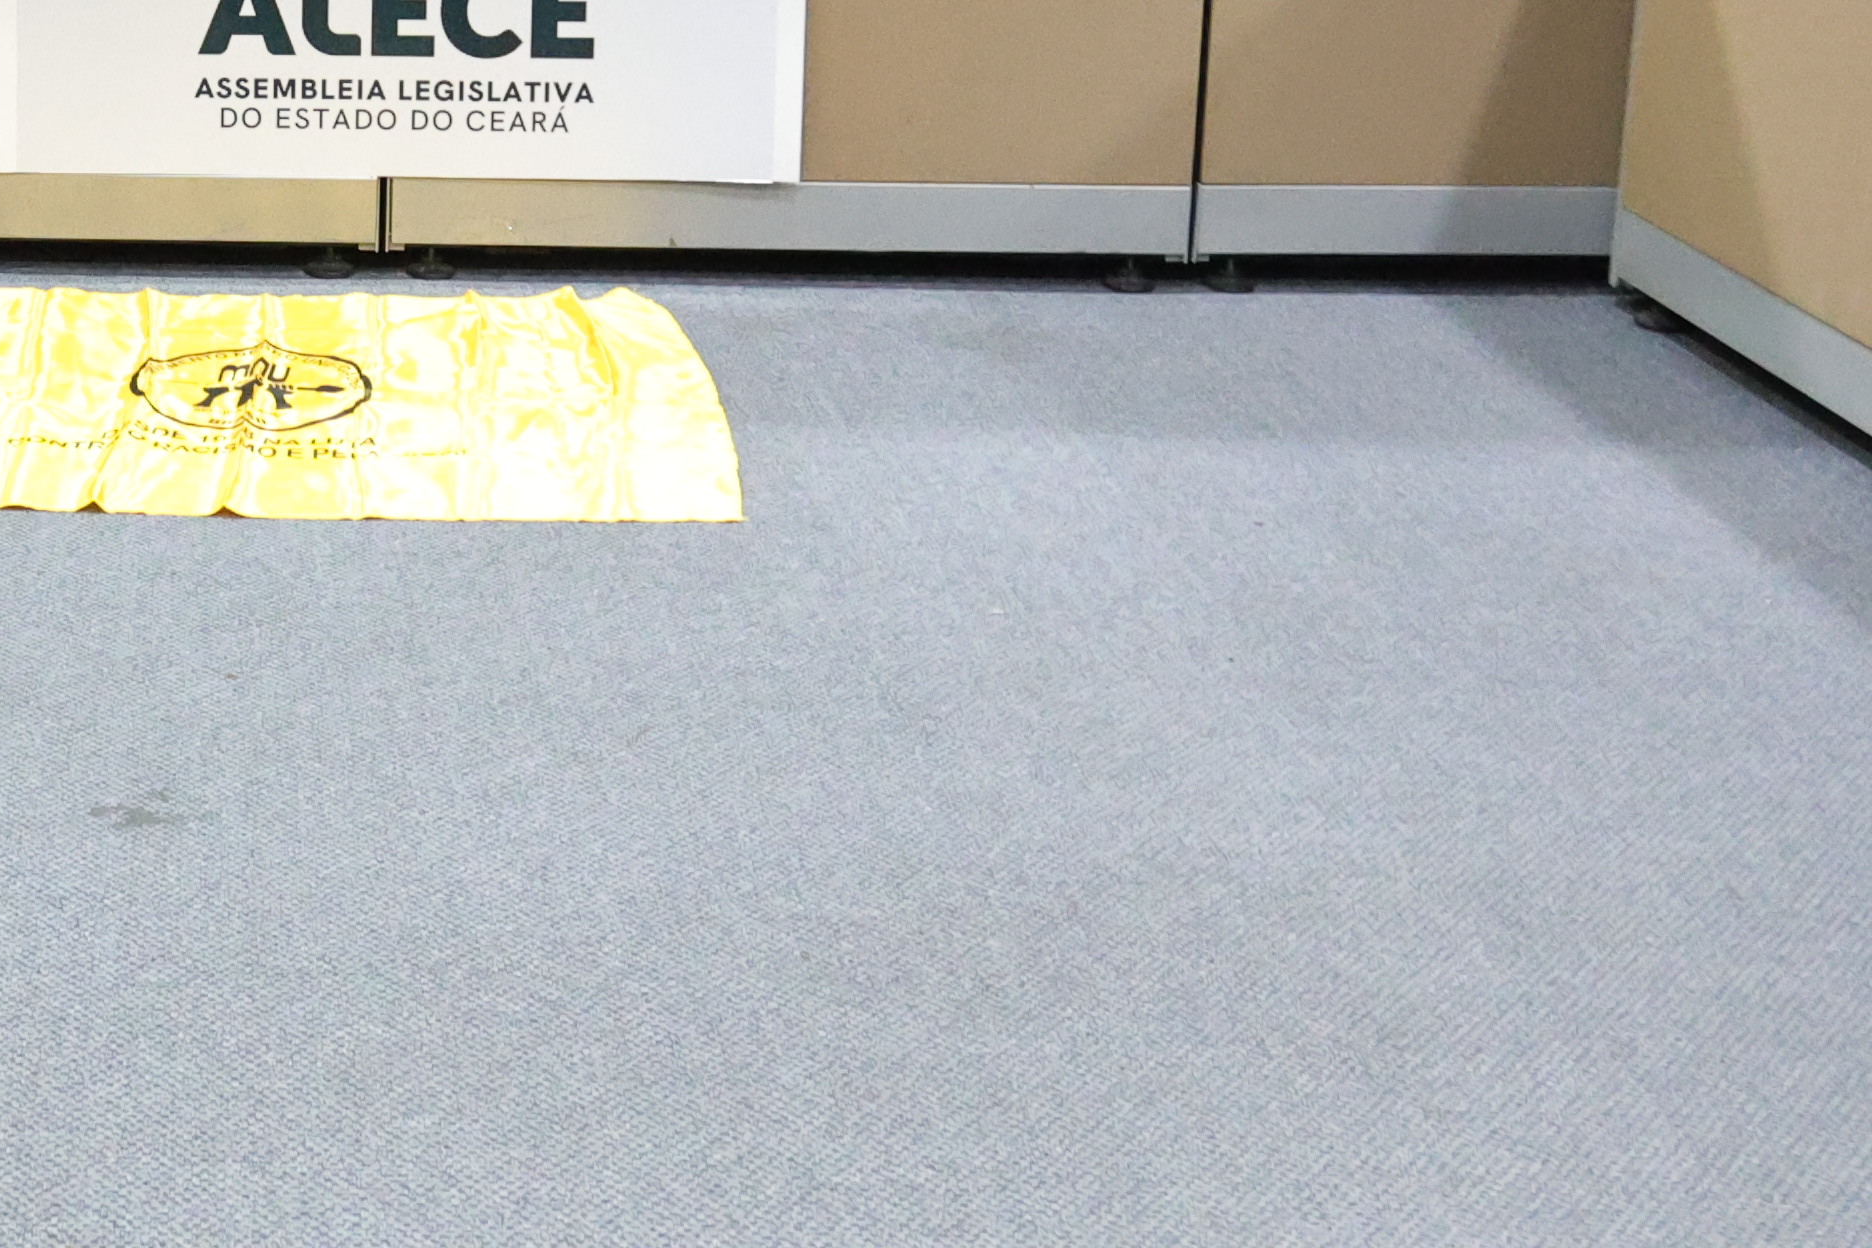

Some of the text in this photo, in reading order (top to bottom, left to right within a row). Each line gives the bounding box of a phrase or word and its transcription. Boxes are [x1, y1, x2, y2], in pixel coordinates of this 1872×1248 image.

[195, 78, 593, 103] ASSEMBLEIA LEGISLATIVA
[221, 107, 568, 132] DO ESTADO DO CEARÁ
